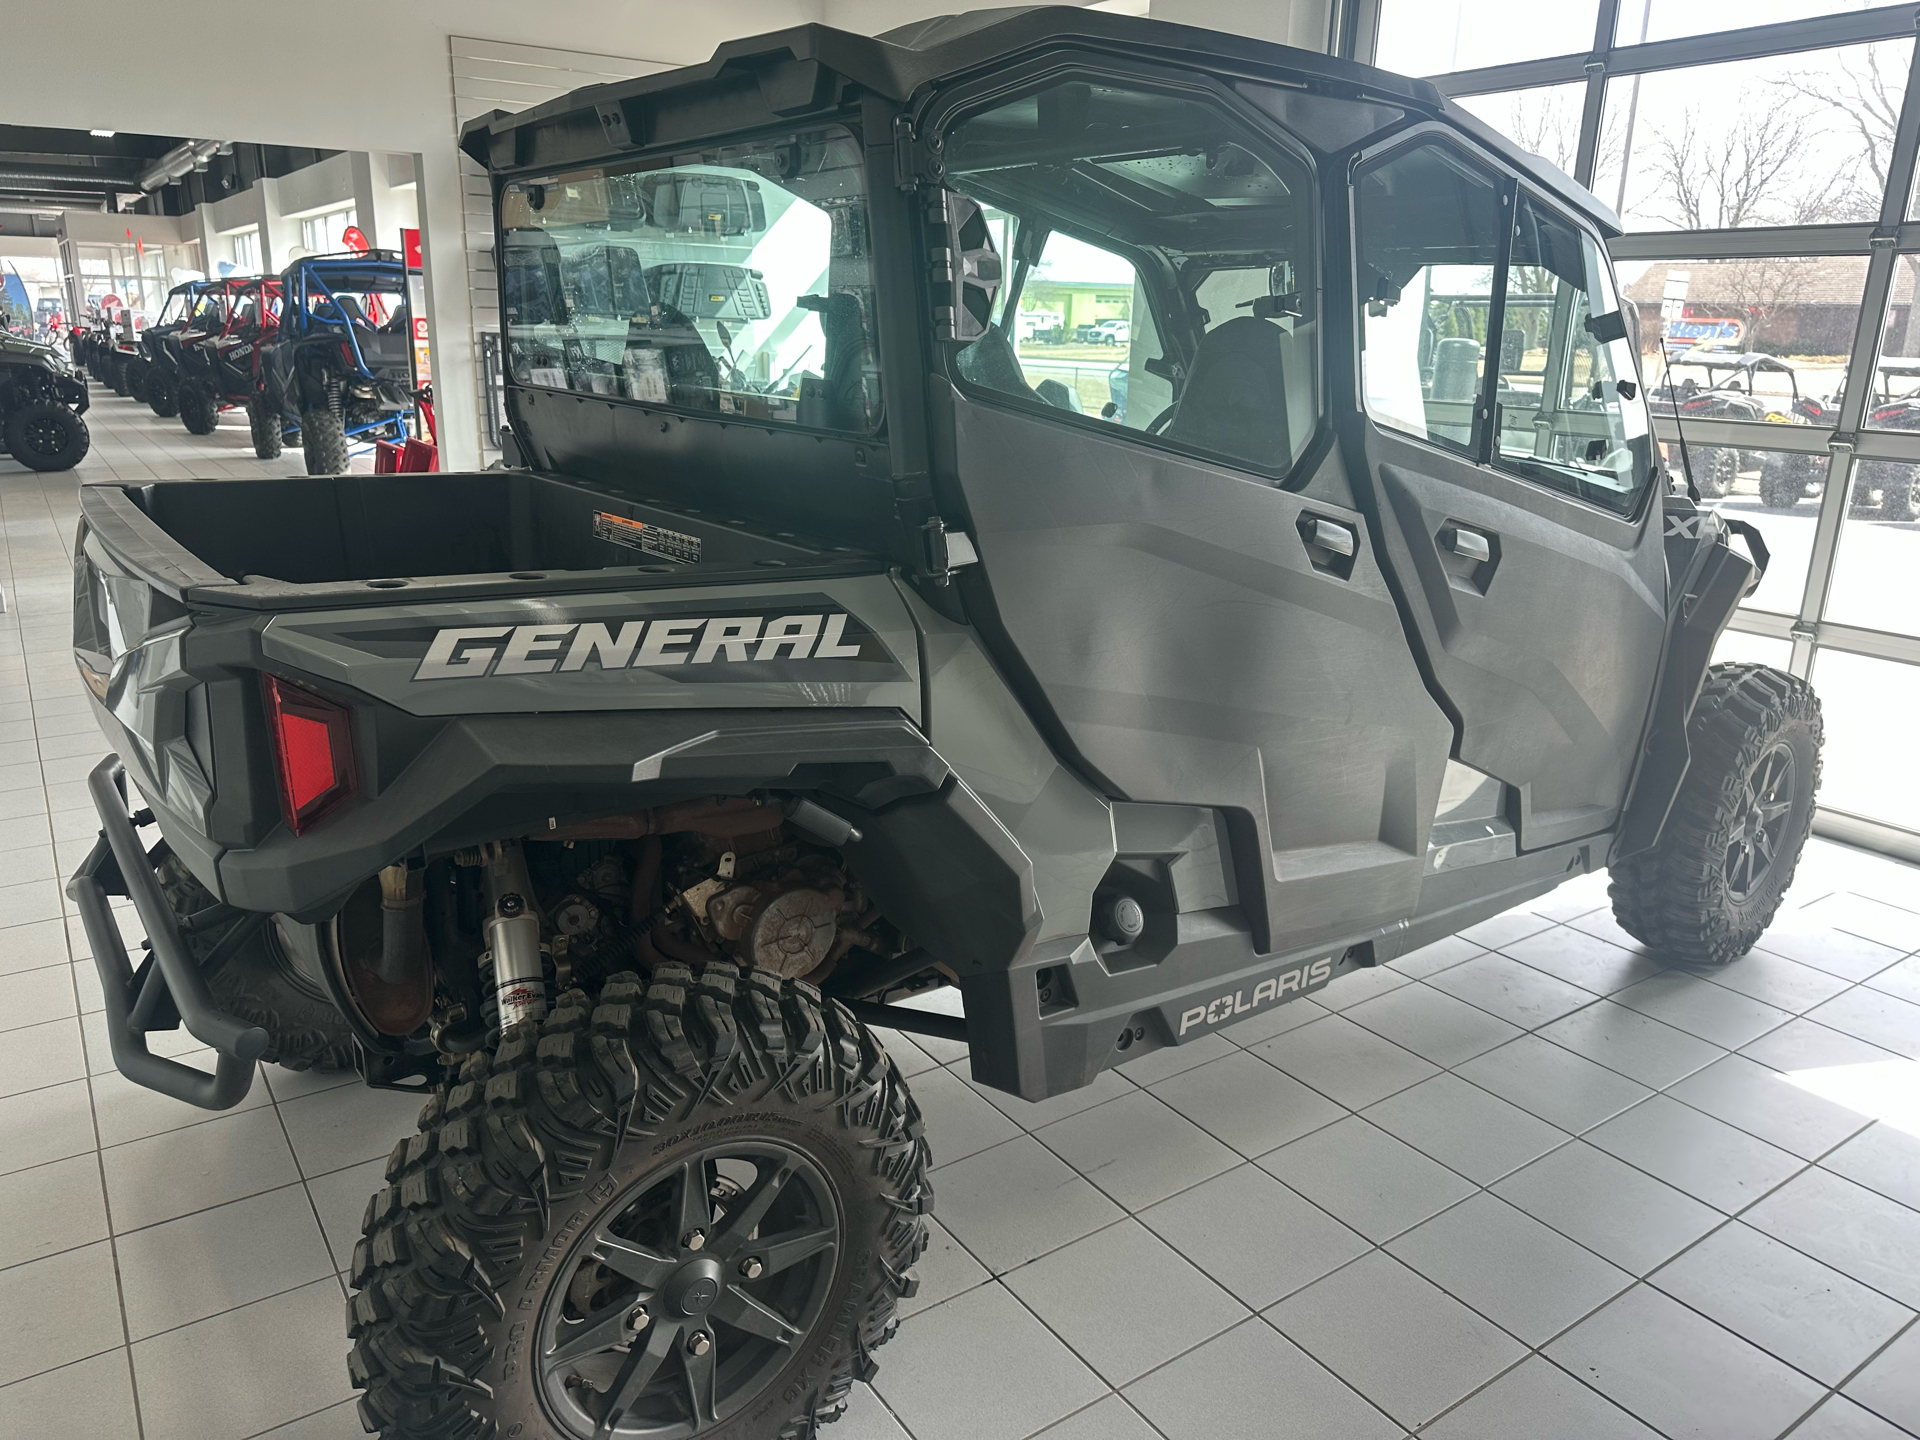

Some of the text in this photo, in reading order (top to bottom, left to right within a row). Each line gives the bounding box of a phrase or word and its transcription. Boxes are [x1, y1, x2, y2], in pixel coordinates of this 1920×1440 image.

[228, 343, 254, 361] HONDA
[412, 613, 861, 681] GENERAL
[501, 993, 526, 1006] Walker
[1179, 956, 1332, 1036] POLARIS
